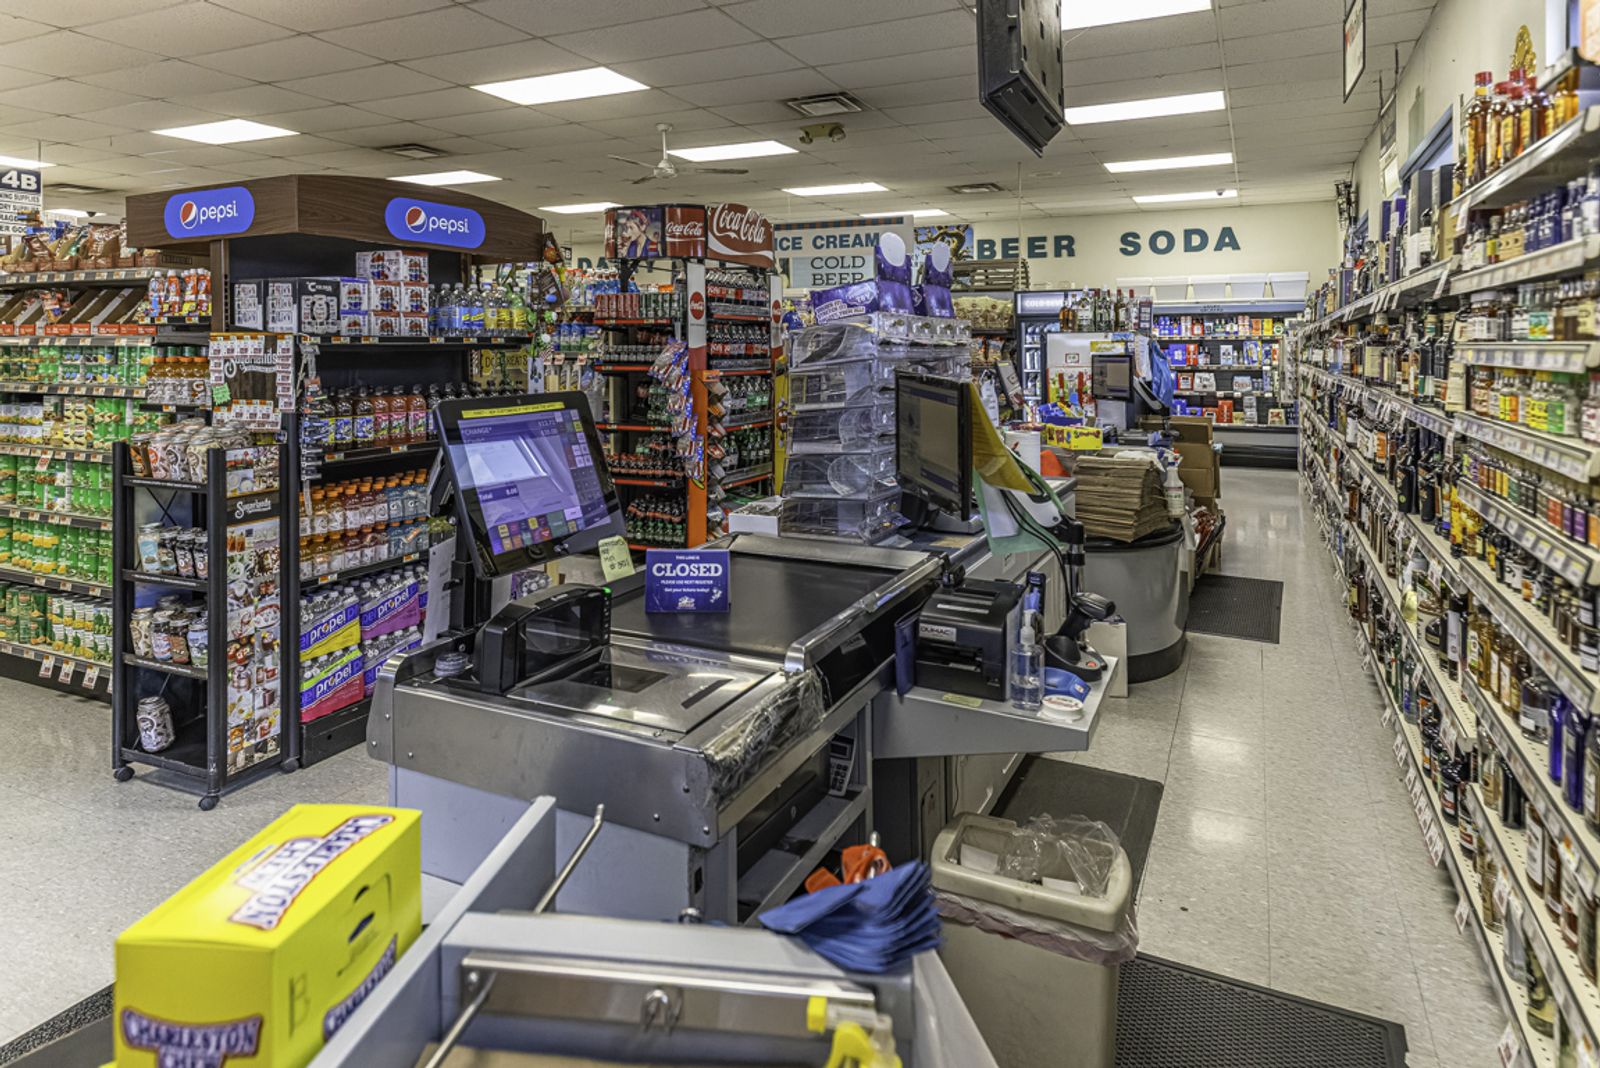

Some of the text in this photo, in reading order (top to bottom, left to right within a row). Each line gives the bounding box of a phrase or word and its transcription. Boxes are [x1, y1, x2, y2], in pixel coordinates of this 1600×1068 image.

[1, 170, 38, 190] 4B
[14, 194, 40, 203] SUPPLIES
[199, 201, 238, 225] pepsi
[713, 203, 766, 244] Coca-Cola
[429, 215, 470, 235] pepsi
[665, 221, 703, 237] Coca-Cola
[774, 232, 880, 251] ICE CREAM
[976, 235, 1076, 260] BEER
[1119, 226, 1241, 257] SODA
[811, 255, 866, 270] COLD
[652, 563, 723, 577] CLOSED
[377, 588, 409, 617] propel
[310, 611, 346, 645] propel
[316, 664, 352, 697] propel
